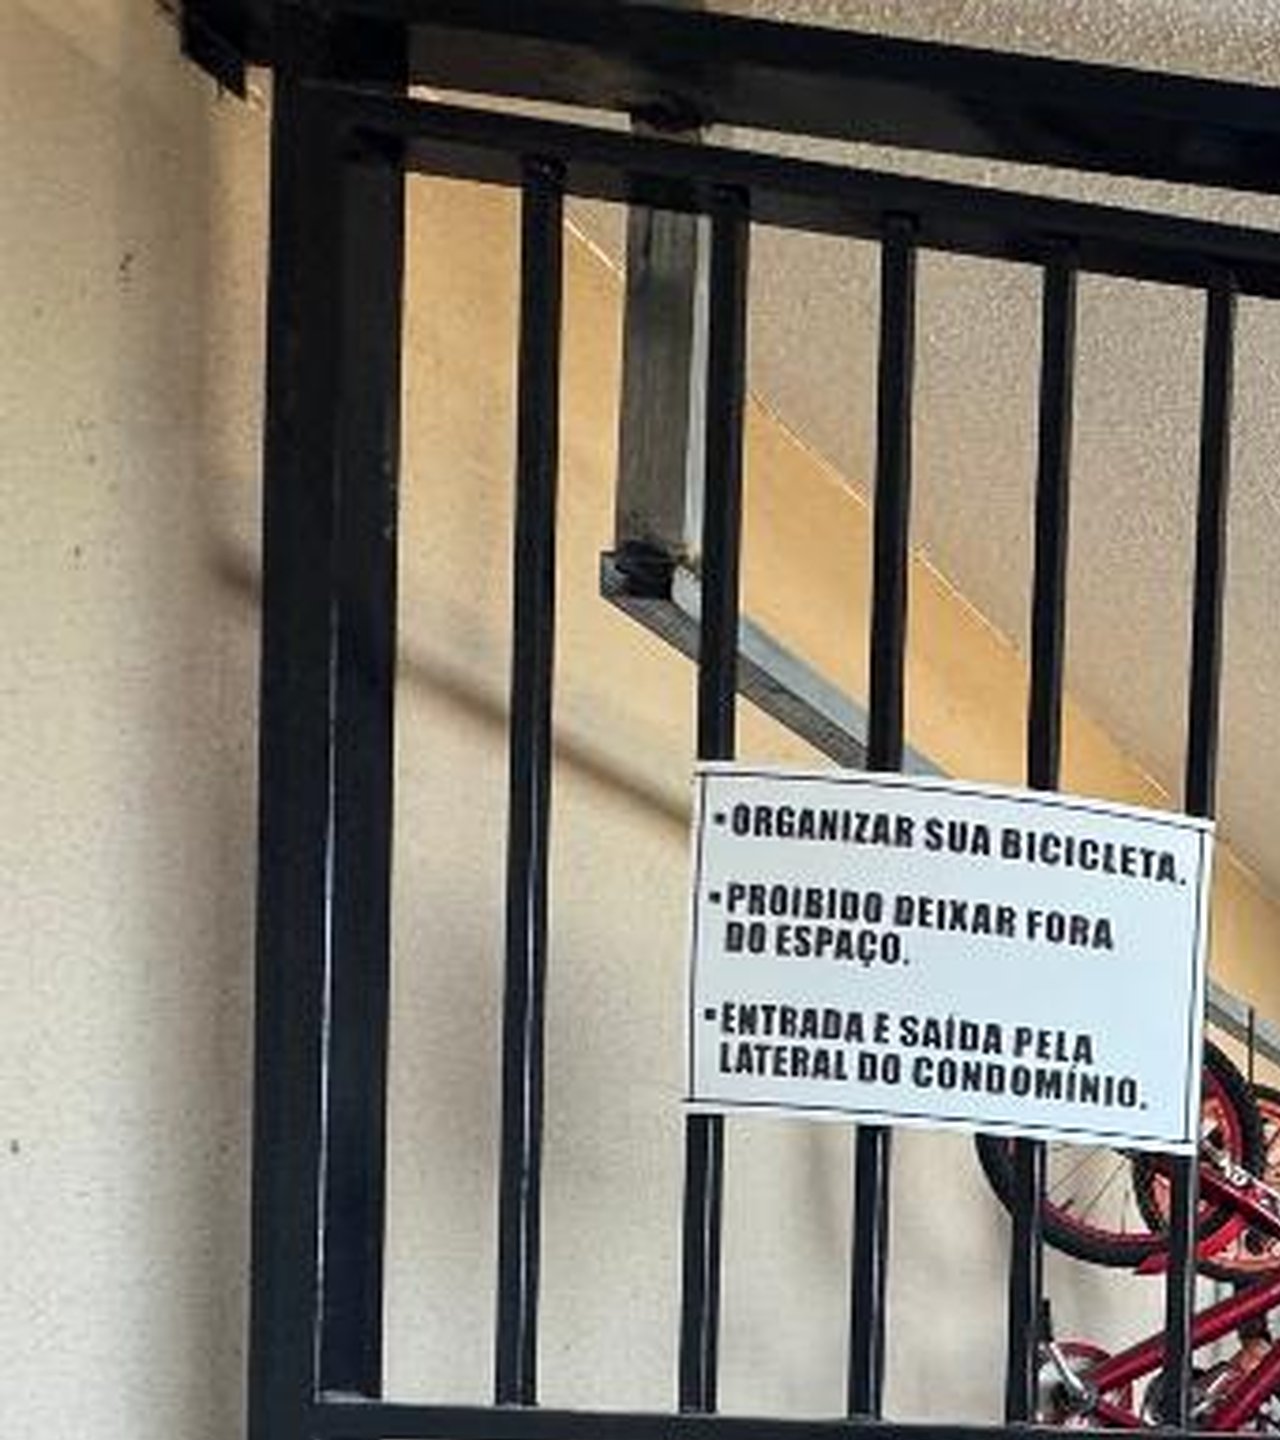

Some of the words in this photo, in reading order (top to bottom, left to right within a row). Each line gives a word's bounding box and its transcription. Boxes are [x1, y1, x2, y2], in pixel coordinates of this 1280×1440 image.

[731, 802, 915, 847] ORGANIZAR
[924, 817, 990, 856] SUA
[1001, 827, 1187, 886] BICICLETA.
[725, 921, 766, 954] DO
[775, 925, 910, 968] ESPAÇO.
[726, 882, 882, 924] PROIBIDO
[893, 895, 1016, 938] DEIXAR
[1027, 909, 1113, 949] FORA
[721, 1002, 864, 1043] ENTRADA
[873, 1012, 890, 1043] E
[899, 1013, 1002, 1055] SAÍDA
[1013, 1027, 1093, 1065] PELA
[720, 1042, 848, 1081] LATERAL
[858, 1051, 901, 1084] DO
[912, 1056, 1147, 1110] CONDOMÍNIO.
